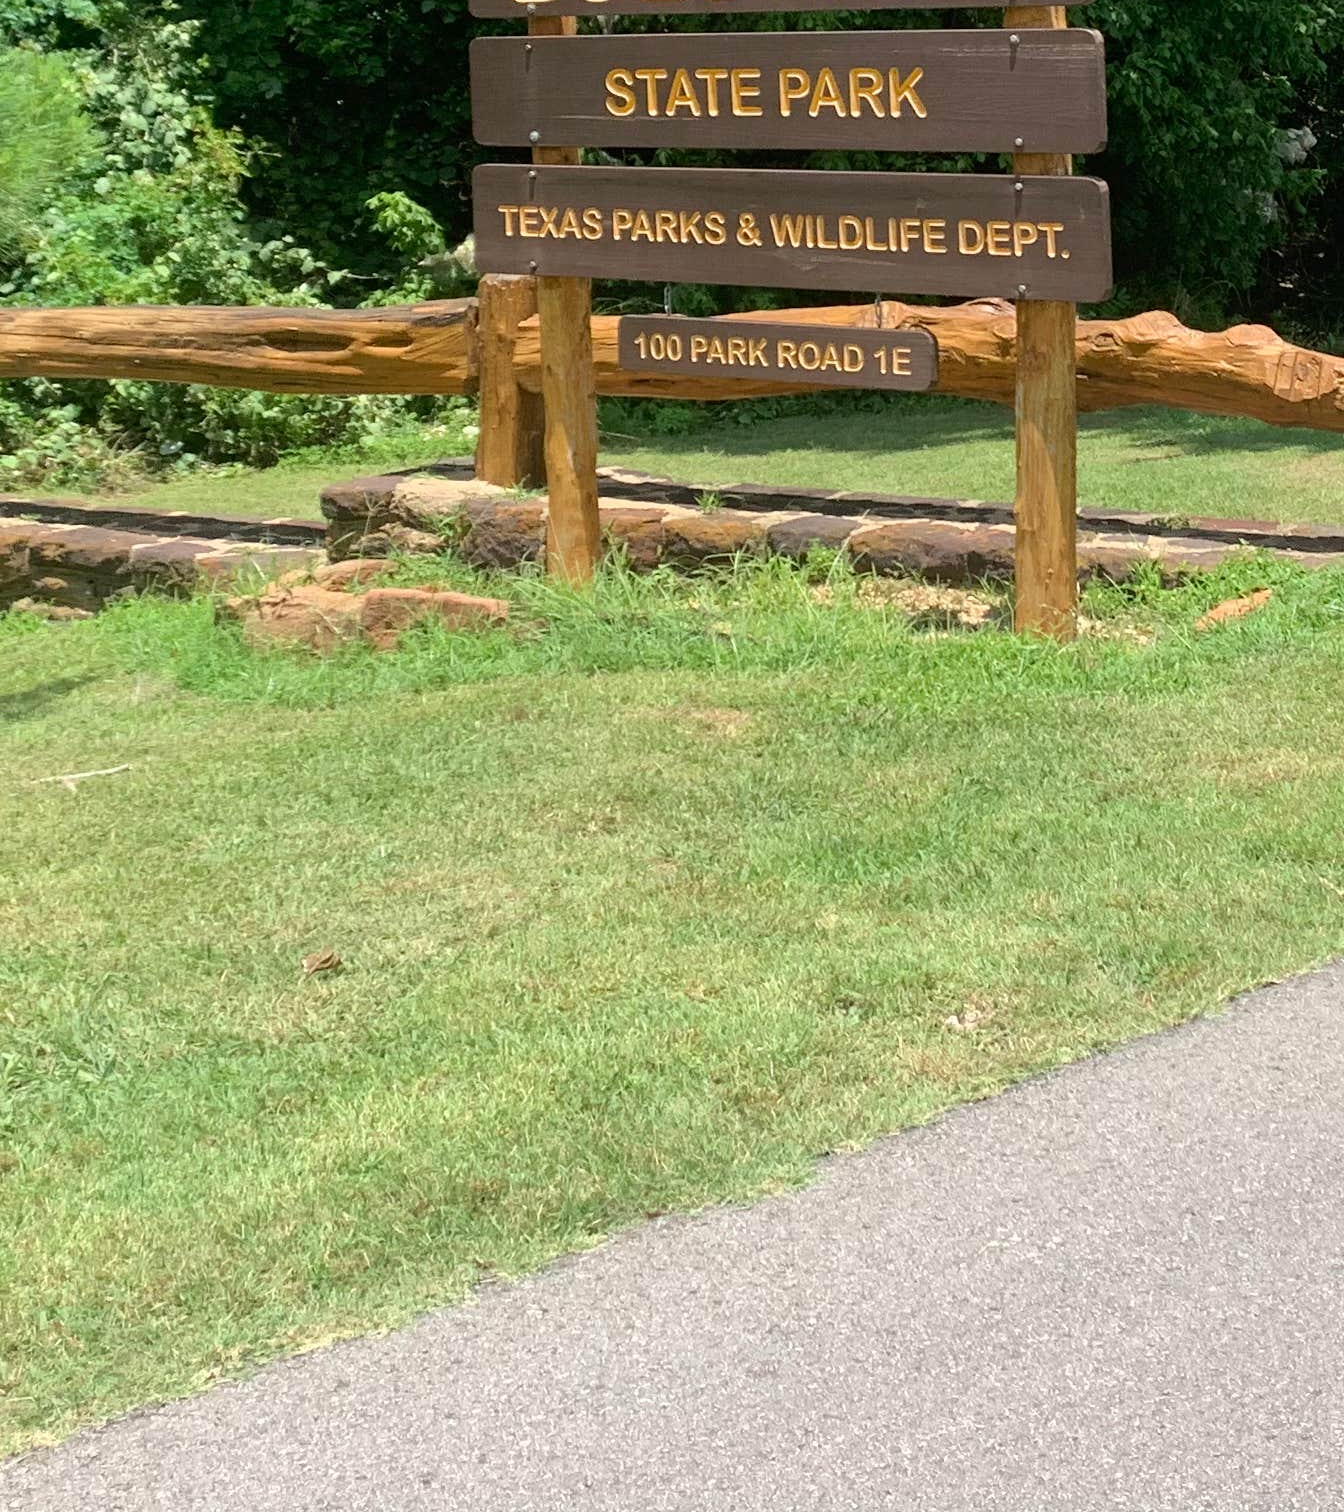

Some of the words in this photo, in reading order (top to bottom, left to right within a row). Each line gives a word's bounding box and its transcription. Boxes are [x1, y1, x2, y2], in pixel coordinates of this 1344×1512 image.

[605, 67, 763, 117] STATE
[779, 67, 928, 118] PARK
[498, 205, 603, 240] TEXAS
[612, 208, 726, 246] PARKS
[736, 212, 762, 247] &
[769, 213, 947, 254] WILDLIFE
[958, 220, 1072, 260] DEPT.
[633, 331, 682, 362] 100
[690, 334, 768, 367] PARK
[776, 340, 864, 374] ROAD
[873, 345, 912, 376] 1E
